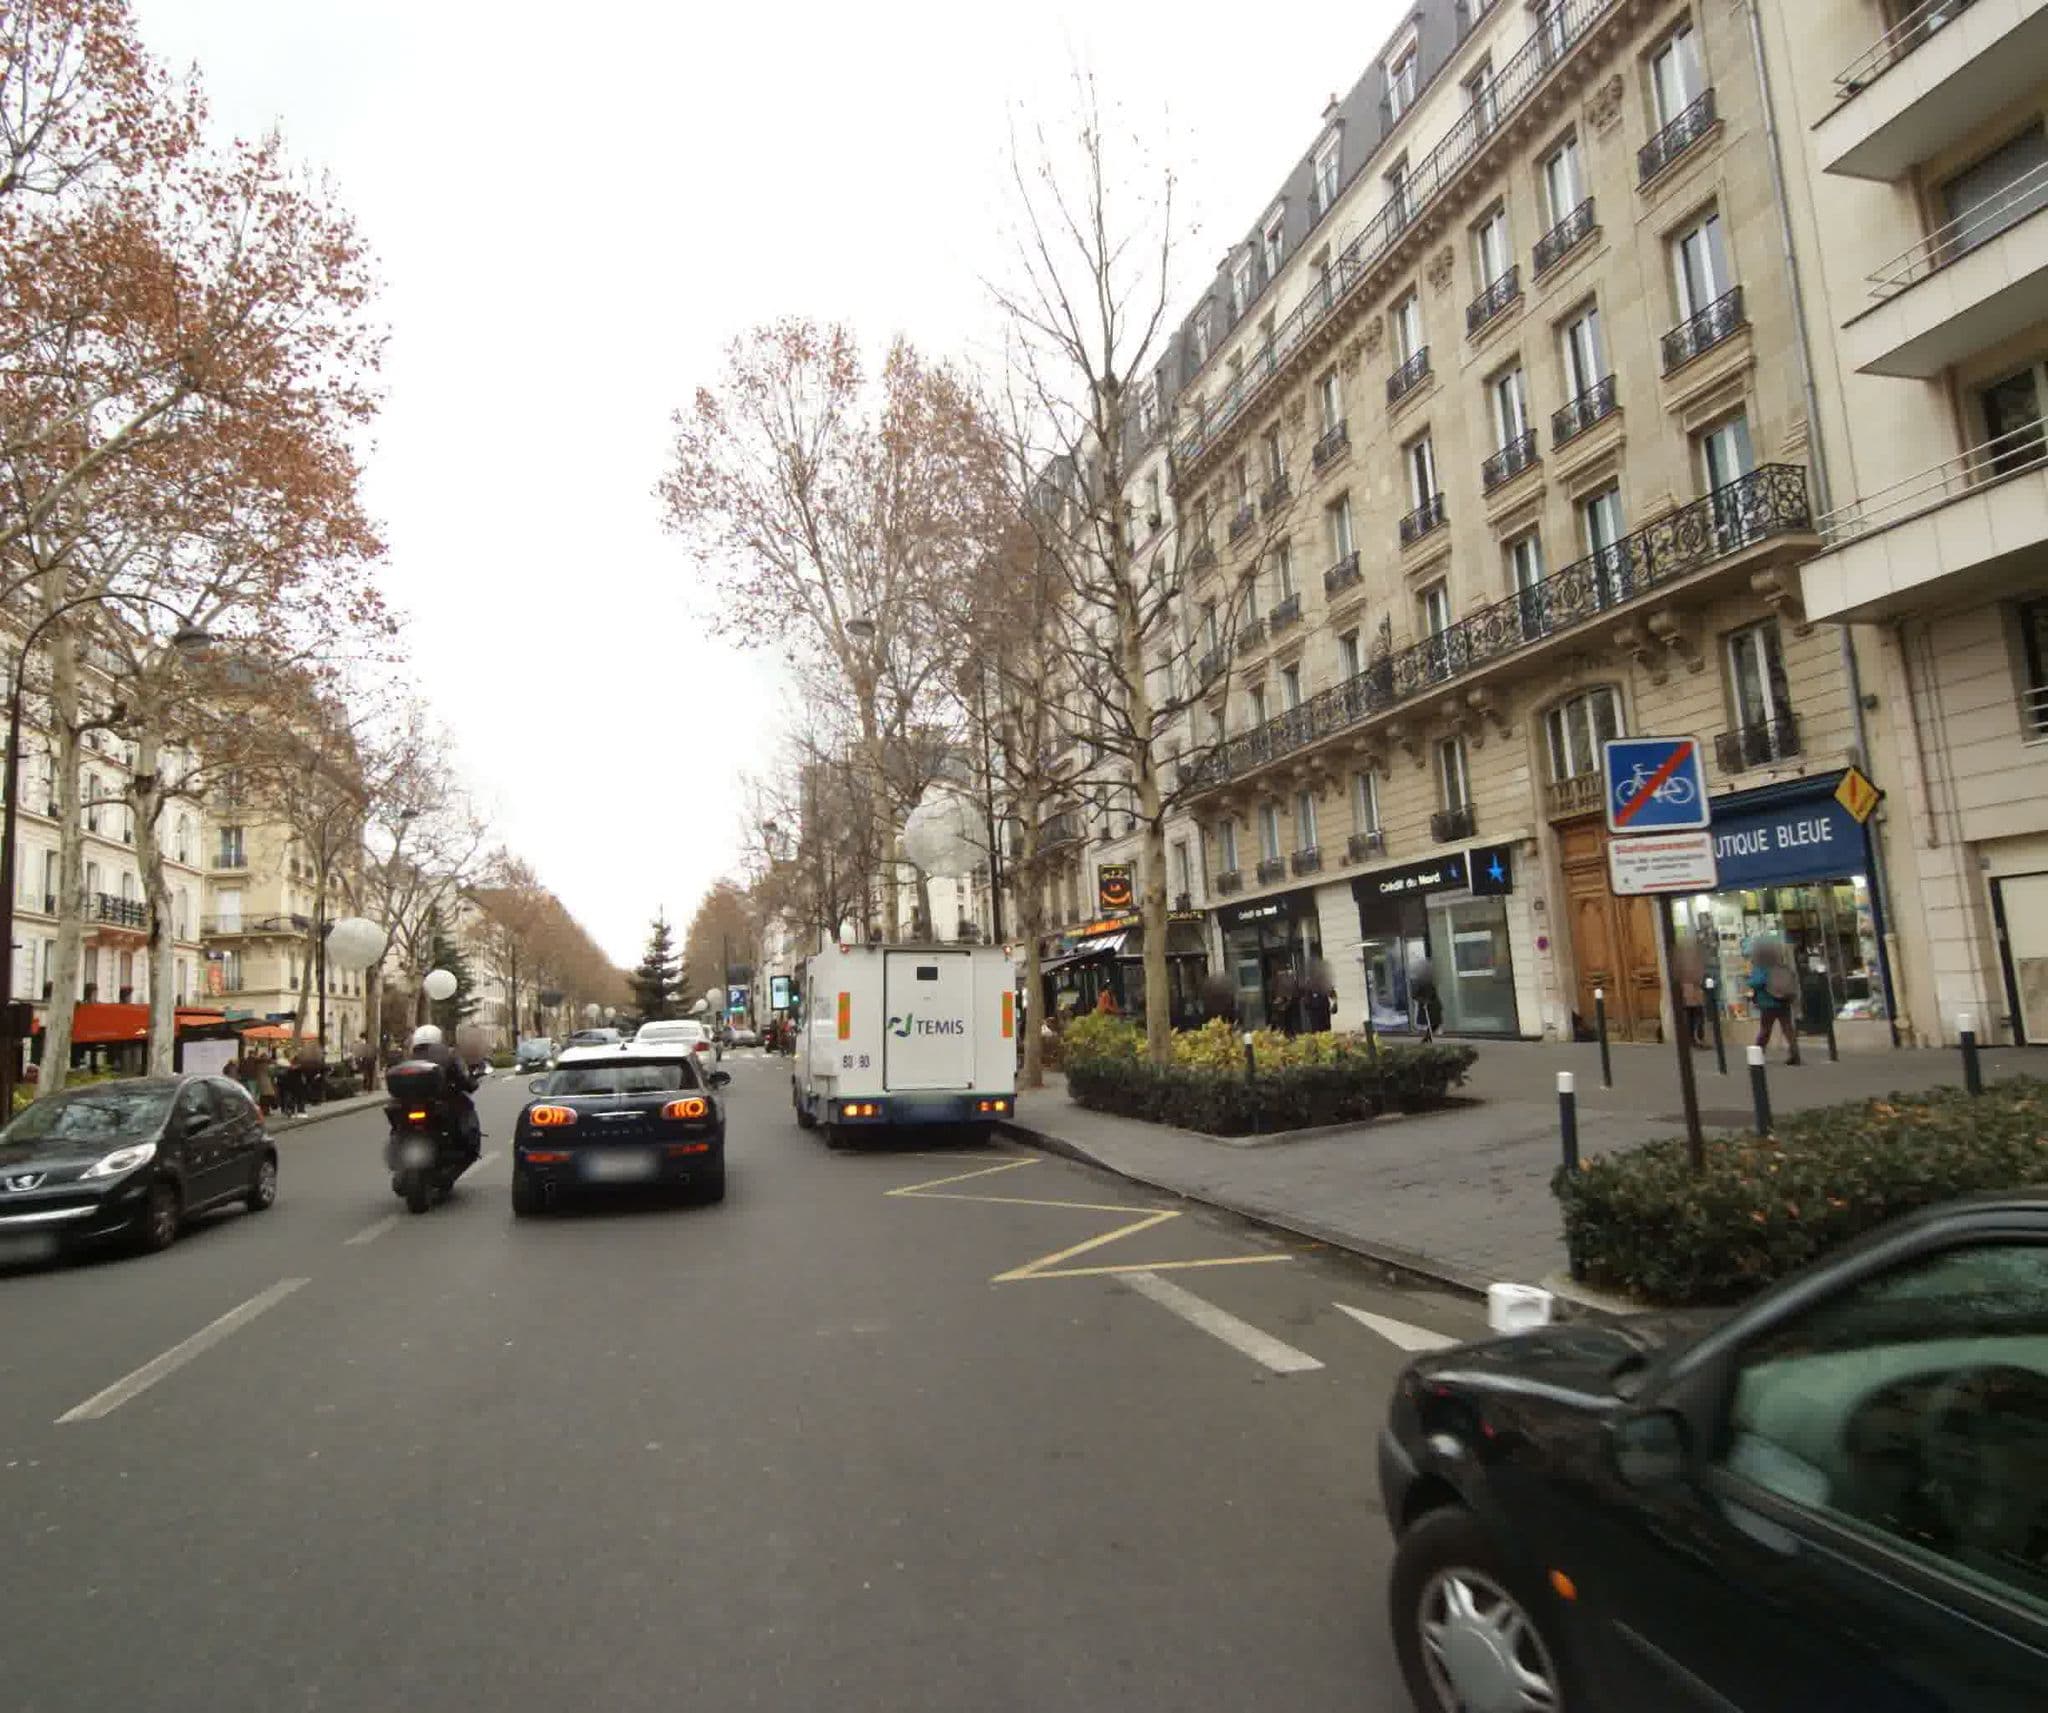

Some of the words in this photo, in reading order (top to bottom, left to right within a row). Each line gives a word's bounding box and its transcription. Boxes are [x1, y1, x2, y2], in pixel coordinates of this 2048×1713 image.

[1776, 817, 1833, 848] BLEUE
[1418, 871, 1441, 885] Nord
[916, 1019, 964, 1035] TEMIS
